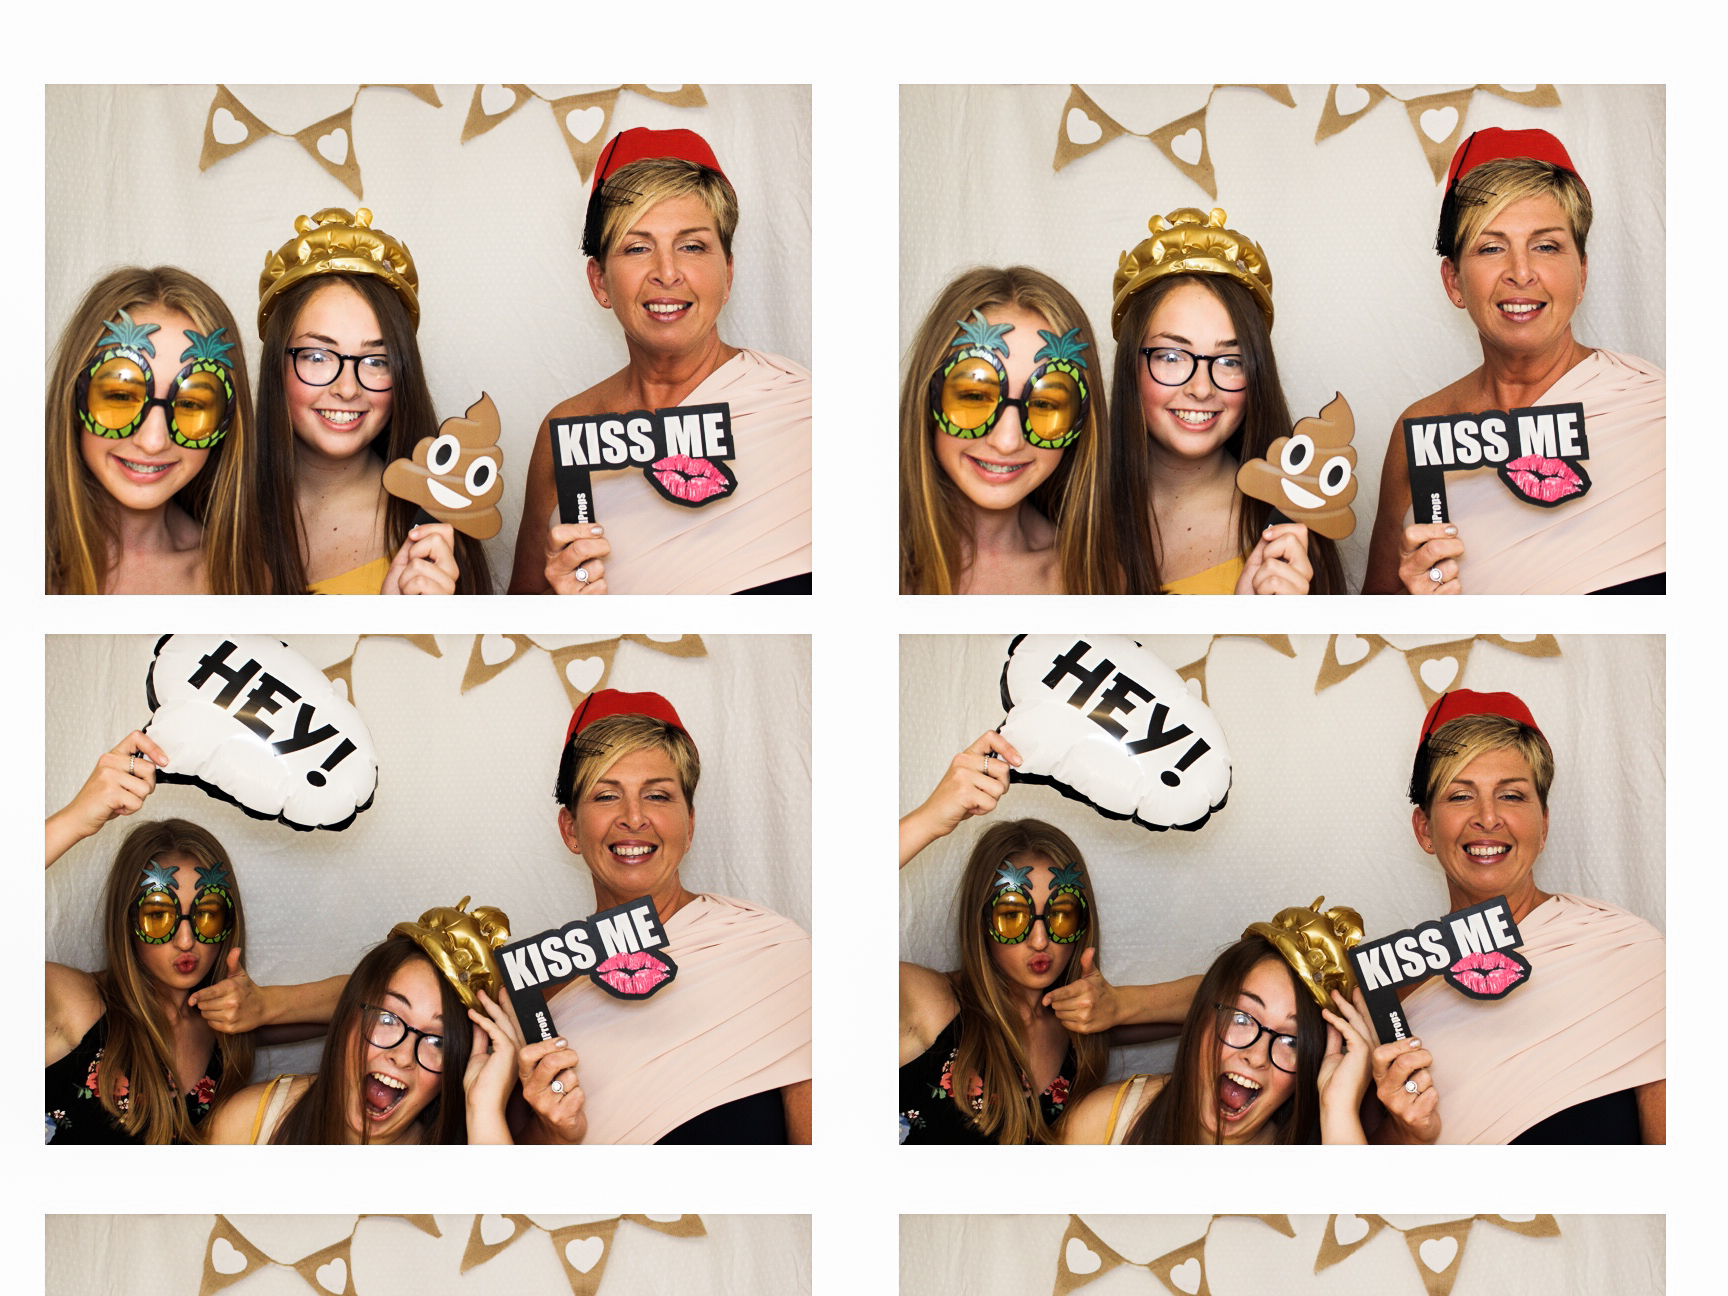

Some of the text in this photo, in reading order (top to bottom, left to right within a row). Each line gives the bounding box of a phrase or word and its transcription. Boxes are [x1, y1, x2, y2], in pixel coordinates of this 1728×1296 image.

[557, 412, 728, 467] KISS ME
[1411, 412, 1582, 467] KISS ME
[187, 639, 358, 788] HEY!
[1041, 639, 1212, 788] HEY!
[502, 905, 662, 992] KISS ME
[1356, 905, 1516, 992] KISS ME
